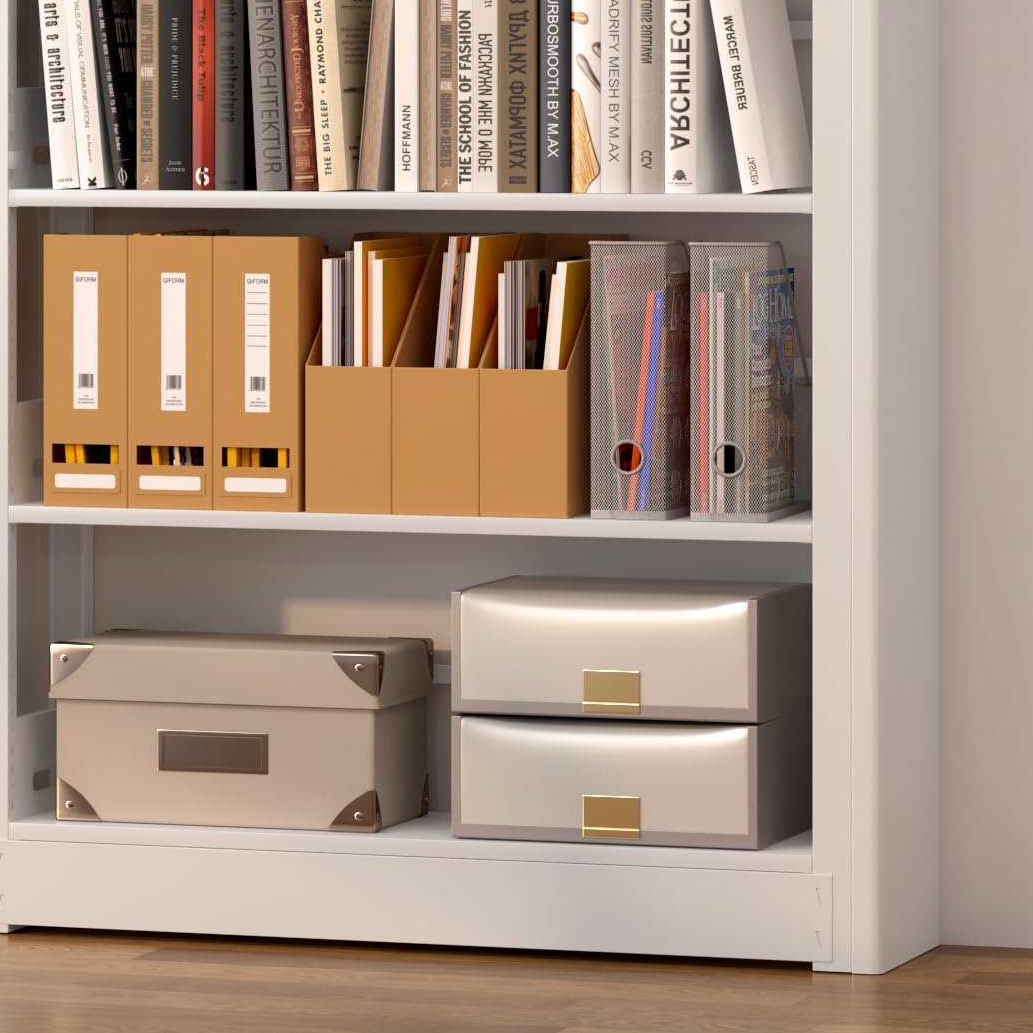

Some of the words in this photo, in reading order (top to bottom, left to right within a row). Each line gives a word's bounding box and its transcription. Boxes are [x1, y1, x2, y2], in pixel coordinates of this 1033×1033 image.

[44, 2, 58, 27] arts
[316, 27, 326, 85] RAYMOND
[458, 9, 472, 71] FASHION
[47, 48, 65, 124] architecture
[458, 75, 472, 93] OF
[608, 56, 620, 99] MESH
[321, 99, 330, 129] SLEEP
[547, 101, 559, 118] BY
[608, 103, 620, 123] BY
[402, 104, 411, 172] HOFFMANN
[458, 97, 472, 155] SCHOOL
[547, 123, 559, 158] M.AX
[322, 132, 330, 153] BIG
[608, 126, 620, 163] M.AX
[324, 156, 332, 176] THE
[458, 158, 472, 185] THE
